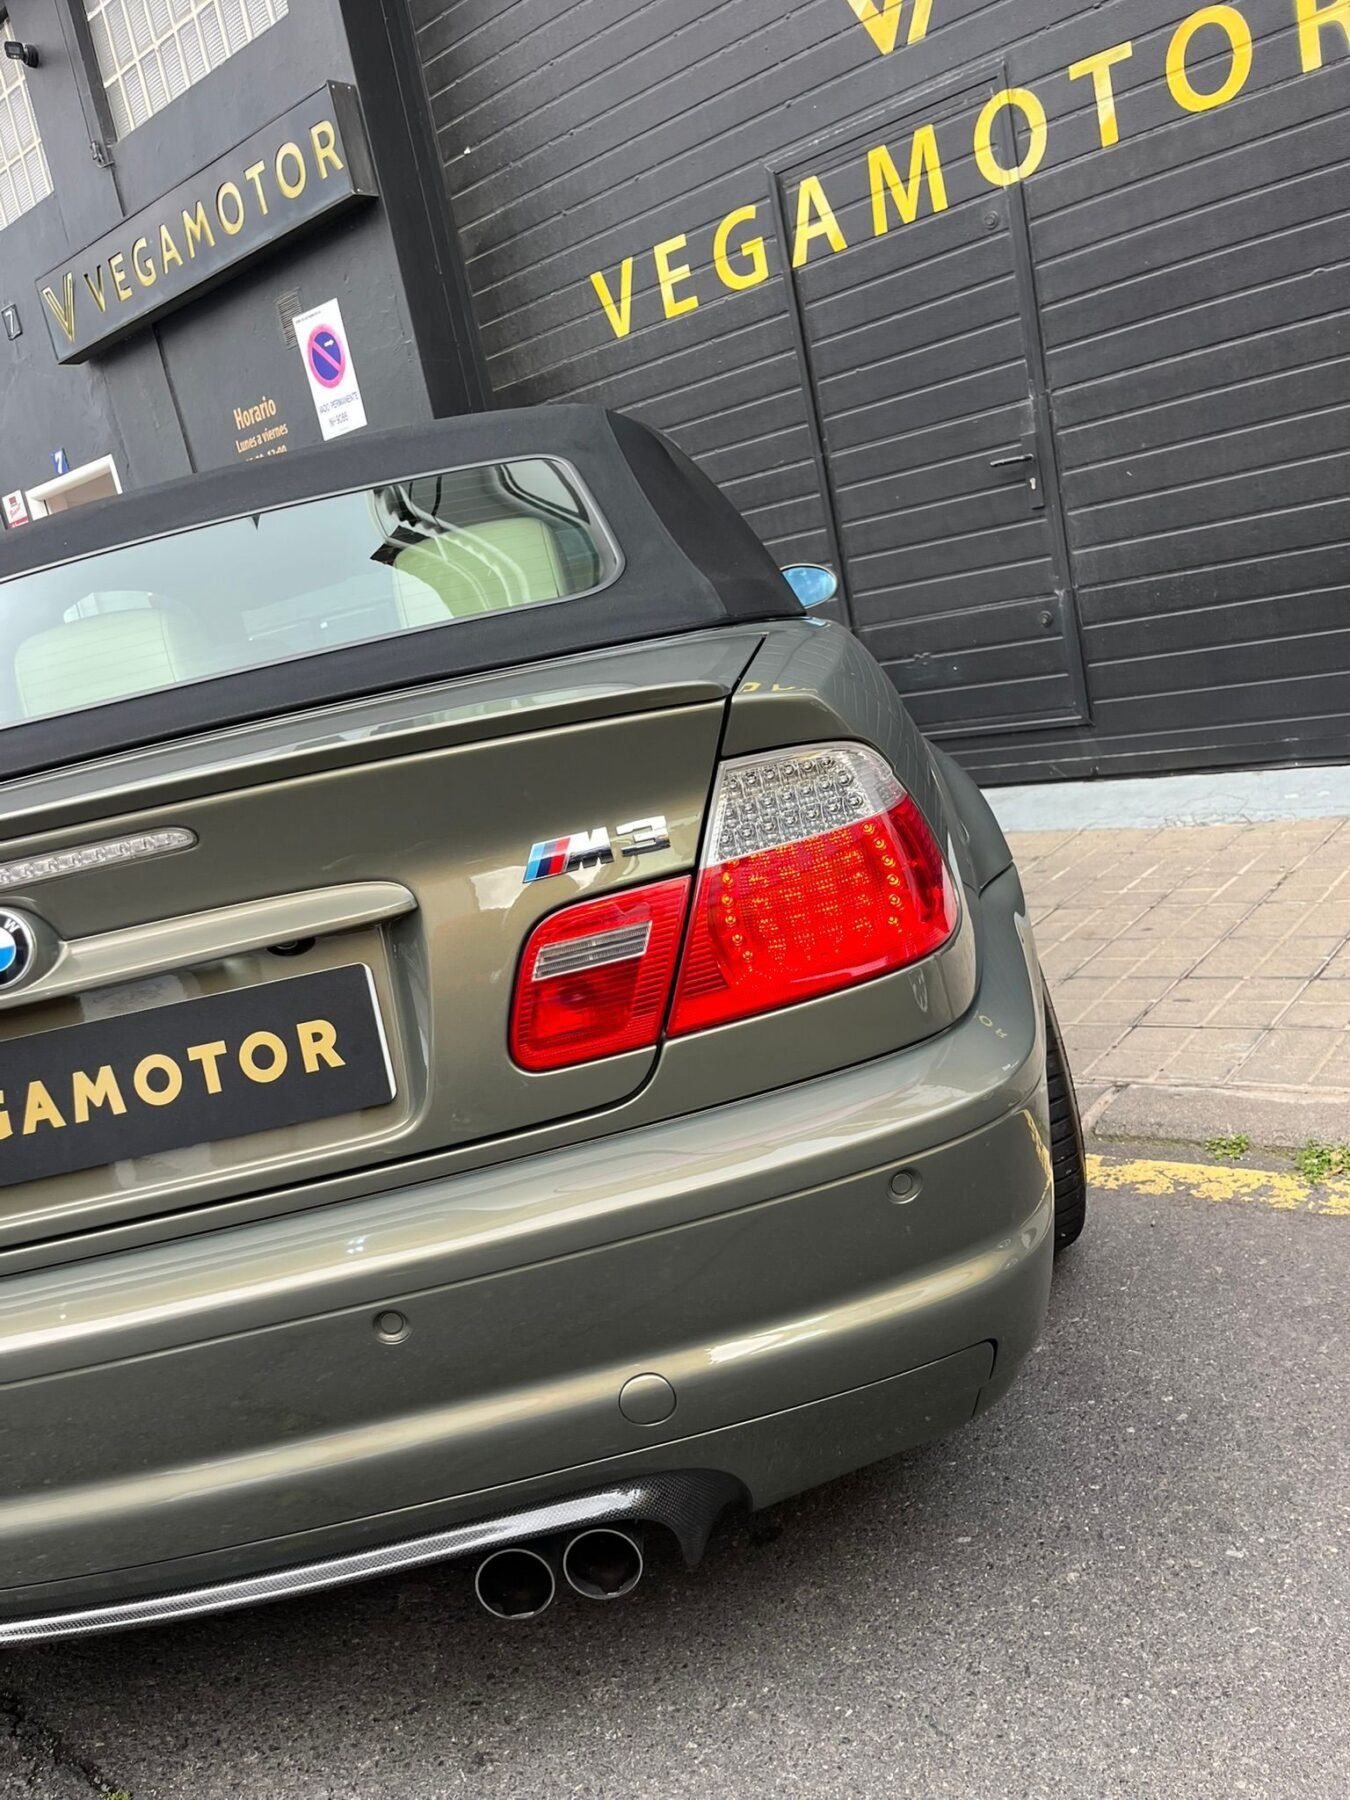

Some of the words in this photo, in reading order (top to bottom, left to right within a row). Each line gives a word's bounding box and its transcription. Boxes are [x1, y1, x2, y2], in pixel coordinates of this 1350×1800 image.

[83, 119, 345, 313] VEGAMOTOR
[233, 395, 277, 430] Horario
[235, 436, 257, 454] Lunes
[256, 434, 263, 445] a
[261, 423, 289, 442] viernes
[54, 450, 64, 475] 7
[560, 815, 671, 875] M3
